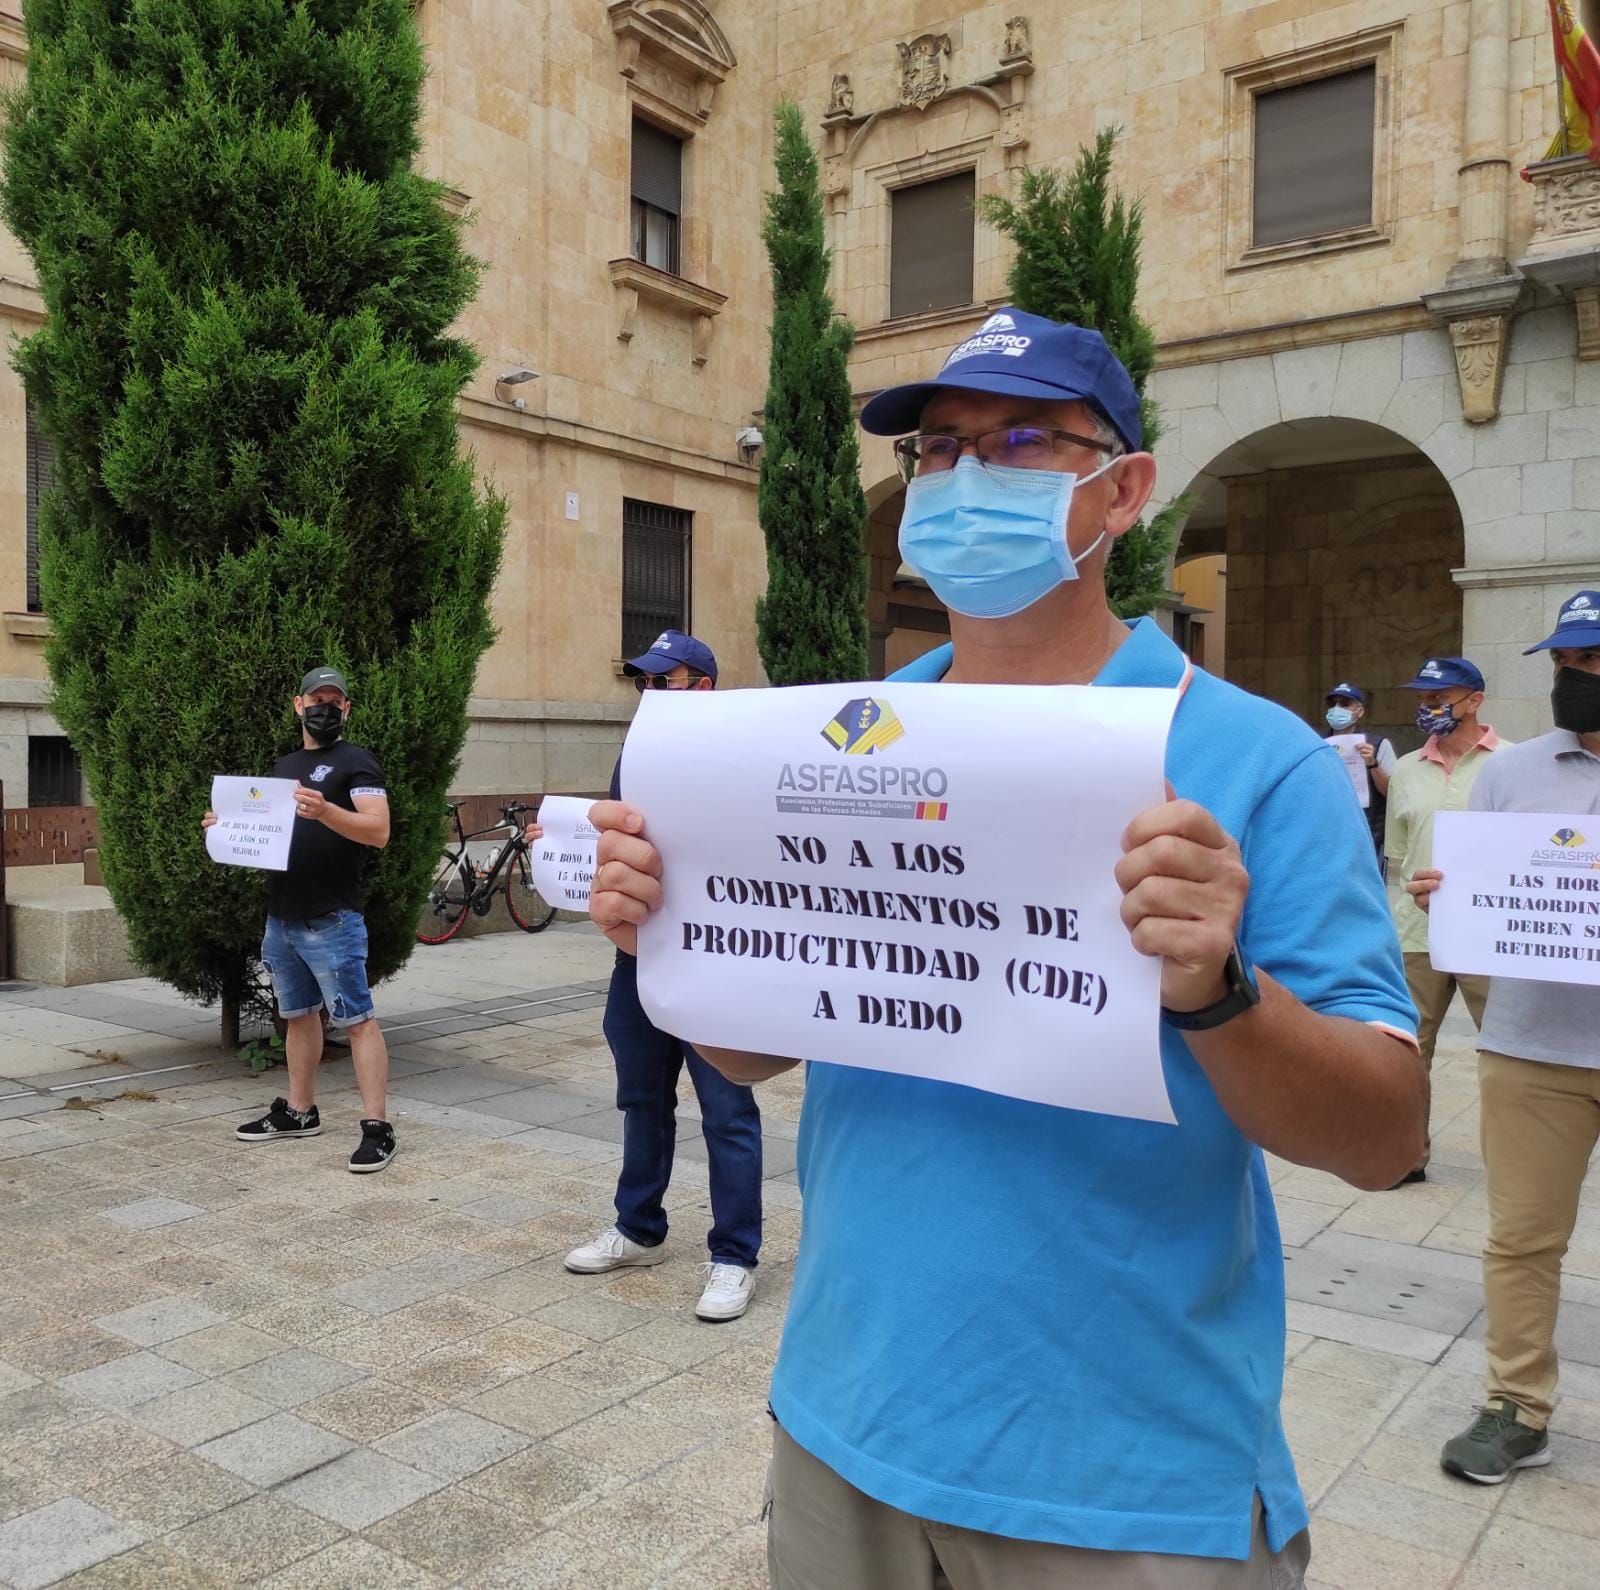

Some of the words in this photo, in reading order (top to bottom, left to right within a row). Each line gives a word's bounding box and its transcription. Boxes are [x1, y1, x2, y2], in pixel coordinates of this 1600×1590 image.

[776, 763, 948, 798] ASFASPRO
[811, 805, 821, 813] las
[822, 806, 850, 815] Fuerzas
[850, 807, 882, 816] Armadas
[857, 800, 866, 808] de
[868, 801, 912, 810] Suboficiales
[542, 851, 556, 861] DE
[559, 852, 582, 865] BONO
[585, 854, 592, 865] A
[776, 835, 827, 865] NO
[848, 839, 874, 868] A
[890, 842, 965, 876] LOS
[558, 870, 568, 881] 15
[1508, 874, 1544, 889] LAS
[1555, 876, 1600, 892] HOR
[706, 875, 1000, 931] COMPLEMENTOS
[1023, 904, 1079, 942] DE
[1471, 893, 1600, 915] EXTRAORDIN
[1506, 919, 1573, 936] DEBEN
[682, 922, 980, 982] PRODUCTIVIDAD
[1005, 958, 1108, 1015] (CDE)
[812, 990, 837, 1020] A
[858, 994, 962, 1034] DEDO
